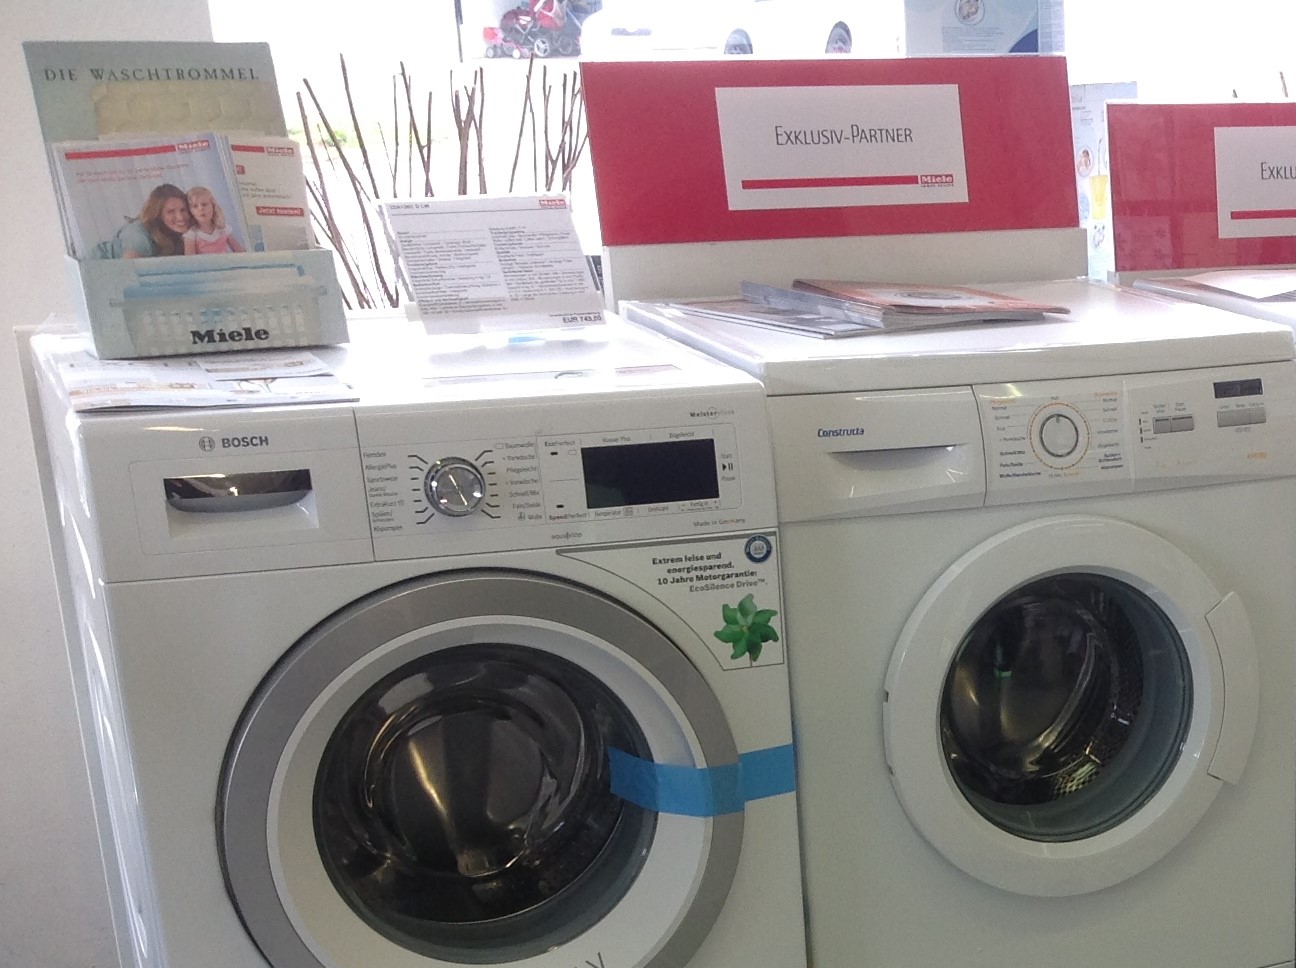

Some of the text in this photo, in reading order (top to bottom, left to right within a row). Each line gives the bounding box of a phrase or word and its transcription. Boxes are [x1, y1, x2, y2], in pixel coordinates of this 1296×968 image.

[44, 67, 260, 82] DIE WASCHTROMMEL
[921, 174, 953, 184] Miele
[191, 327, 270, 344] Miele
[817, 427, 865, 438] Constructa
[221, 435, 269, 449] BOSCH
[652, 552, 722, 565] Extrem leise und
[666, 562, 735, 574] energiesparend.
[657, 577, 669, 585] 10
[670, 575, 694, 584] Jahre
[689, 581, 735, 593] EcoSilence
